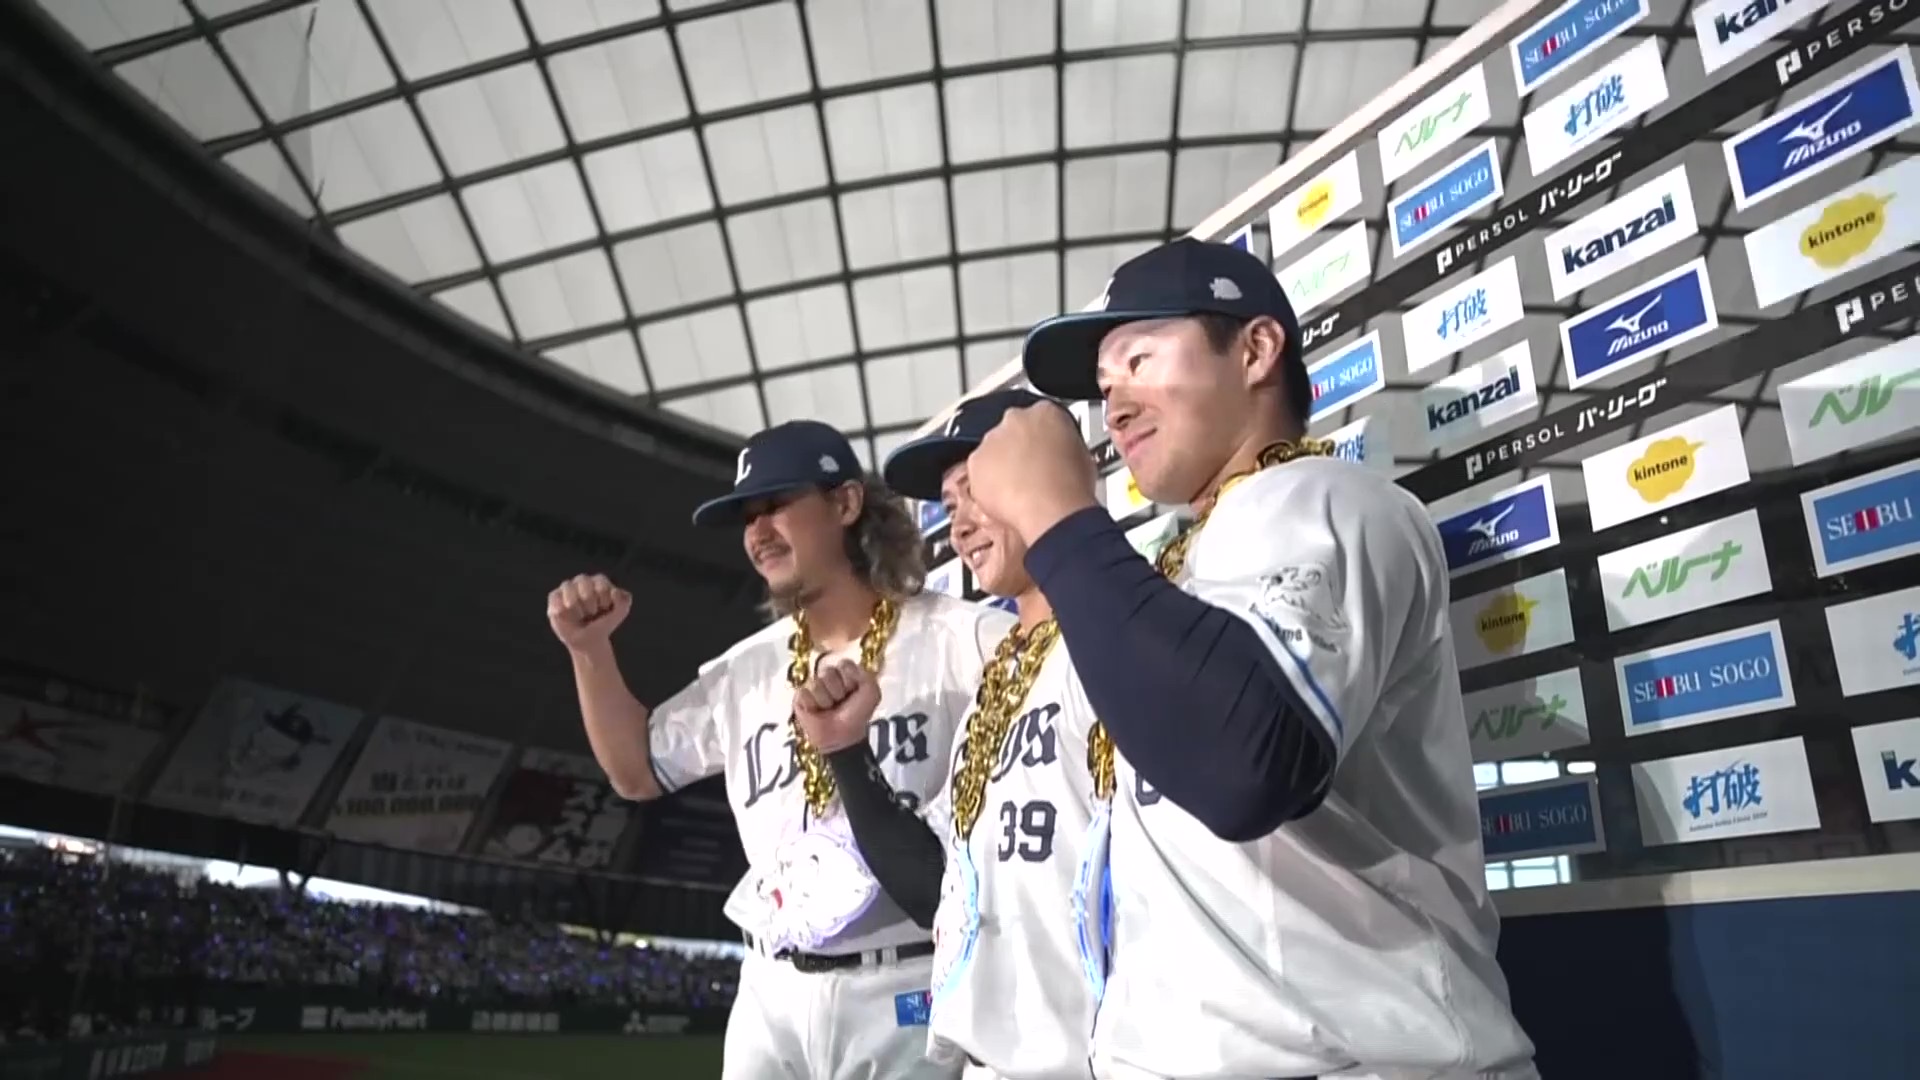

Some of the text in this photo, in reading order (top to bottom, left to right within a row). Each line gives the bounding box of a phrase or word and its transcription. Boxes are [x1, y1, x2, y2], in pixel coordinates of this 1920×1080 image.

[1394, 90, 1472, 157] ベルーナ
[1450, 167, 1489, 200] SOGO
[1456, 209, 1529, 257] PERSOL
[1561, 192, 1676, 275] kanzai
[1807, 210, 1877, 249] kintone
[1427, 365, 1520, 431] kanzai
[1487, 377, 1667, 465] PERSOL パ・リーグ
[1633, 454, 1689, 482] kintone
[1826, 497, 1914, 541] SEIBU
[1622, 540, 1743, 599] ベルーナ
[1481, 611, 1525, 633] kintone
[1634, 656, 1771, 704] SEIBU SOGO
[1469, 693, 1568, 742] ベルーナ
[1682, 762, 1763, 819] 打破
[998, 800, 1057, 863] 39
[1539, 803, 1588, 829] SOGO
